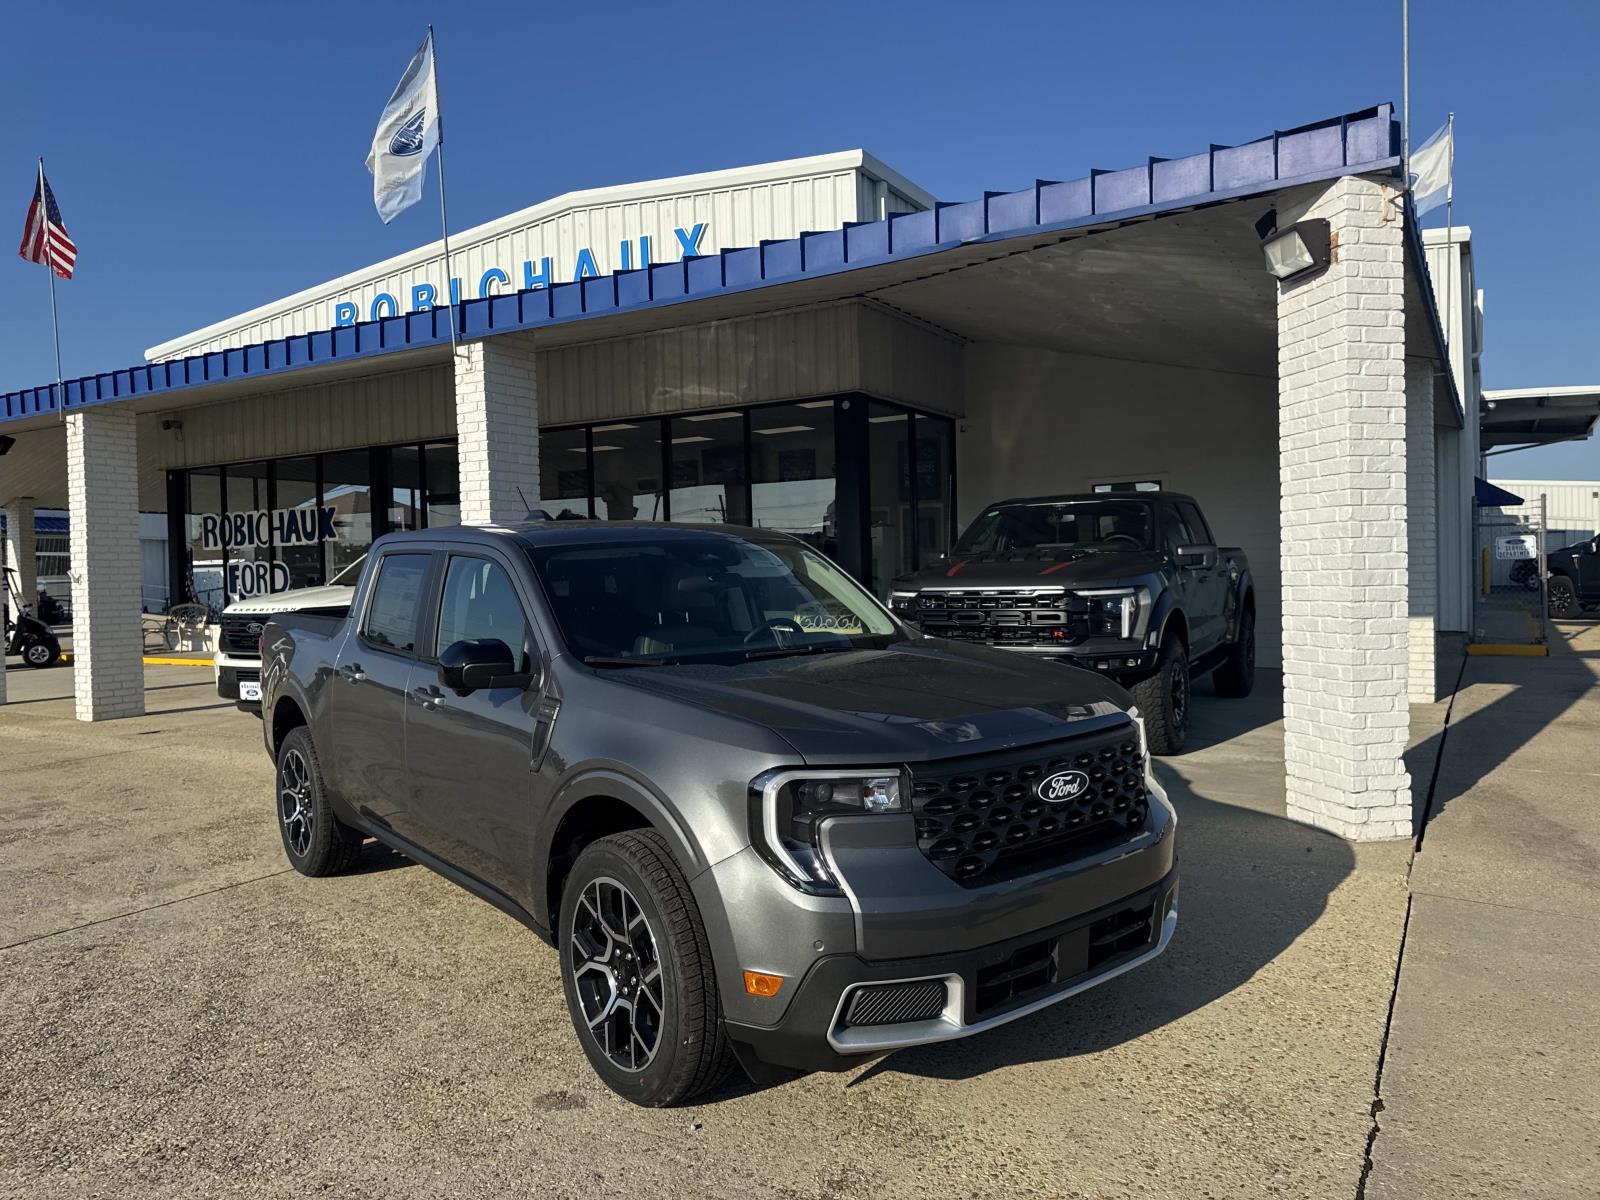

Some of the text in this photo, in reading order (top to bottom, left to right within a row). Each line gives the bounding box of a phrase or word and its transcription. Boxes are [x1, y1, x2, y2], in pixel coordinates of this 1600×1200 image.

[335, 223, 708, 327] ROBICHAUX
[202, 506, 338, 549] ROBICHAUX
[227, 561, 290, 595] FORD
[921, 610, 1068, 625] FORD
[1049, 775, 1080, 798] Ford
